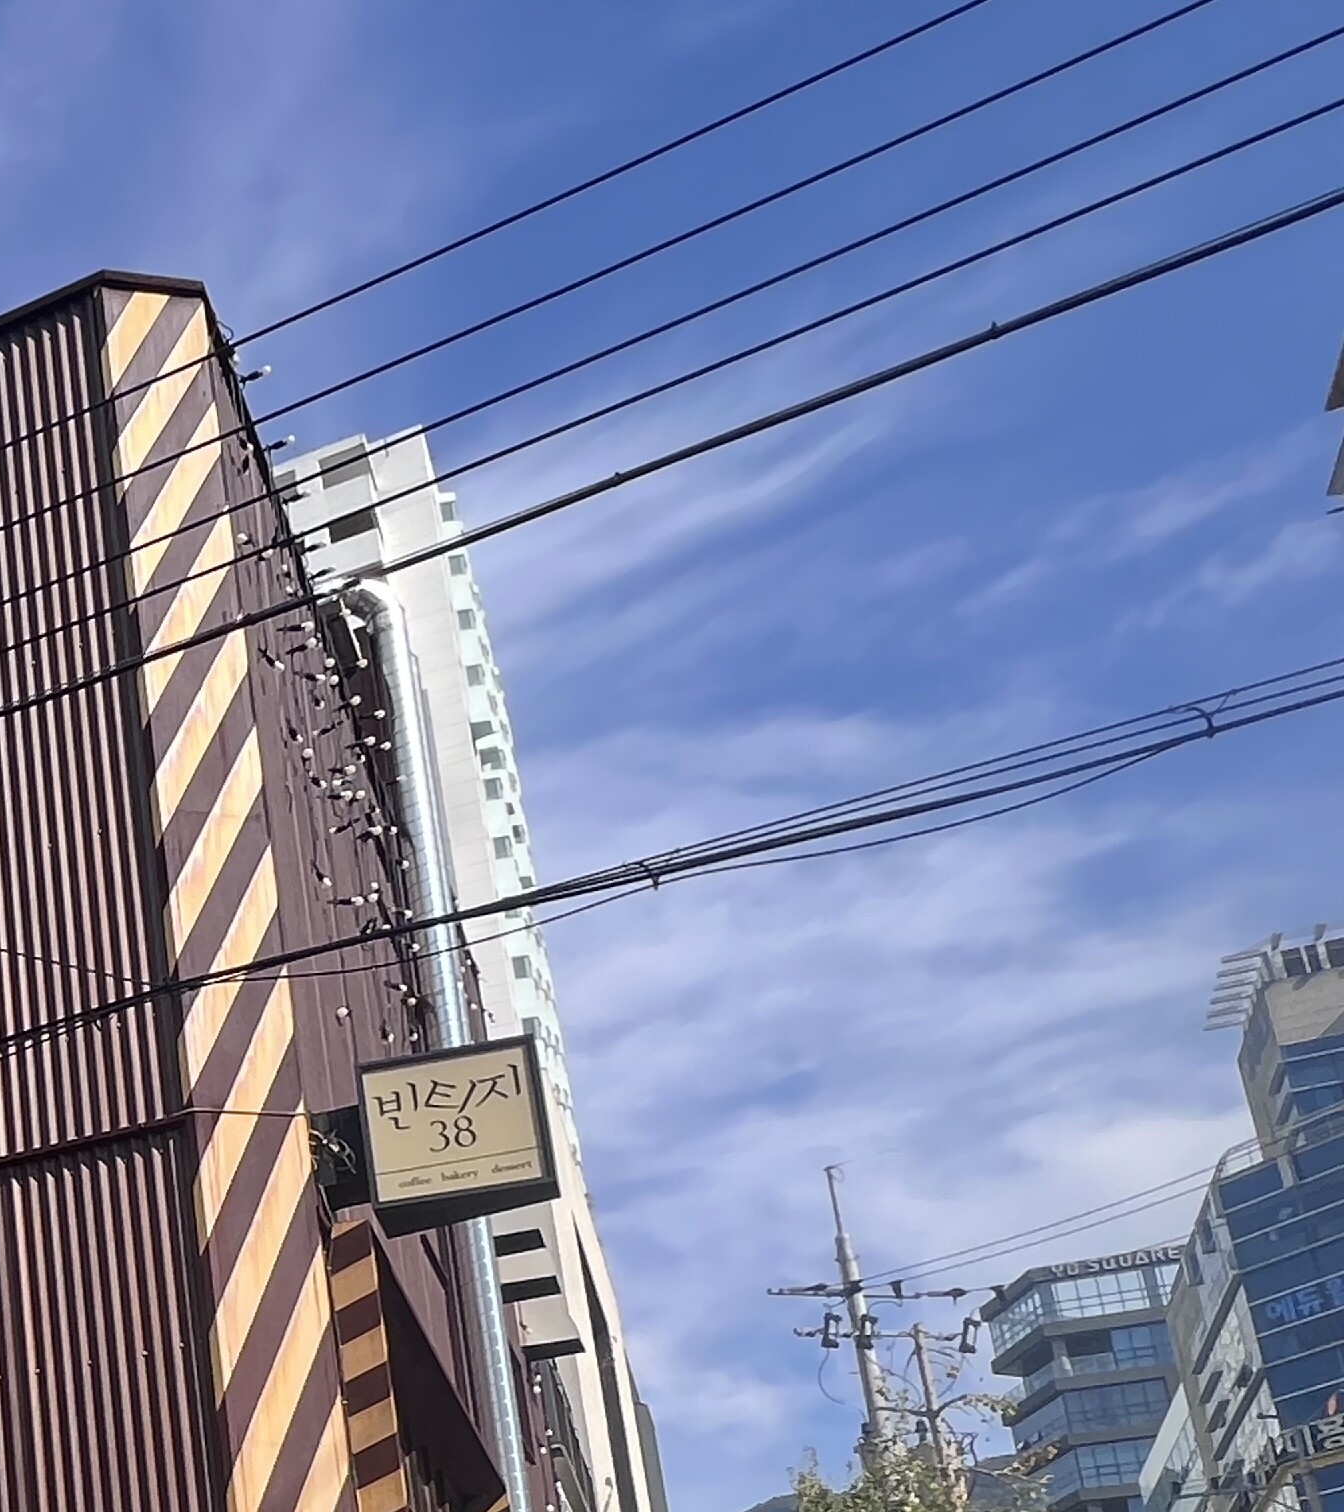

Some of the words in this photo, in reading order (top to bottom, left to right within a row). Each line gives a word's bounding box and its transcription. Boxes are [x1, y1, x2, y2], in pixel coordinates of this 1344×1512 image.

[372, 1064, 521, 1131] 빈티지
[429, 1115, 477, 1153] 38
[398, 1175, 433, 1189] coffee
[440, 1169, 480, 1184] bakery
